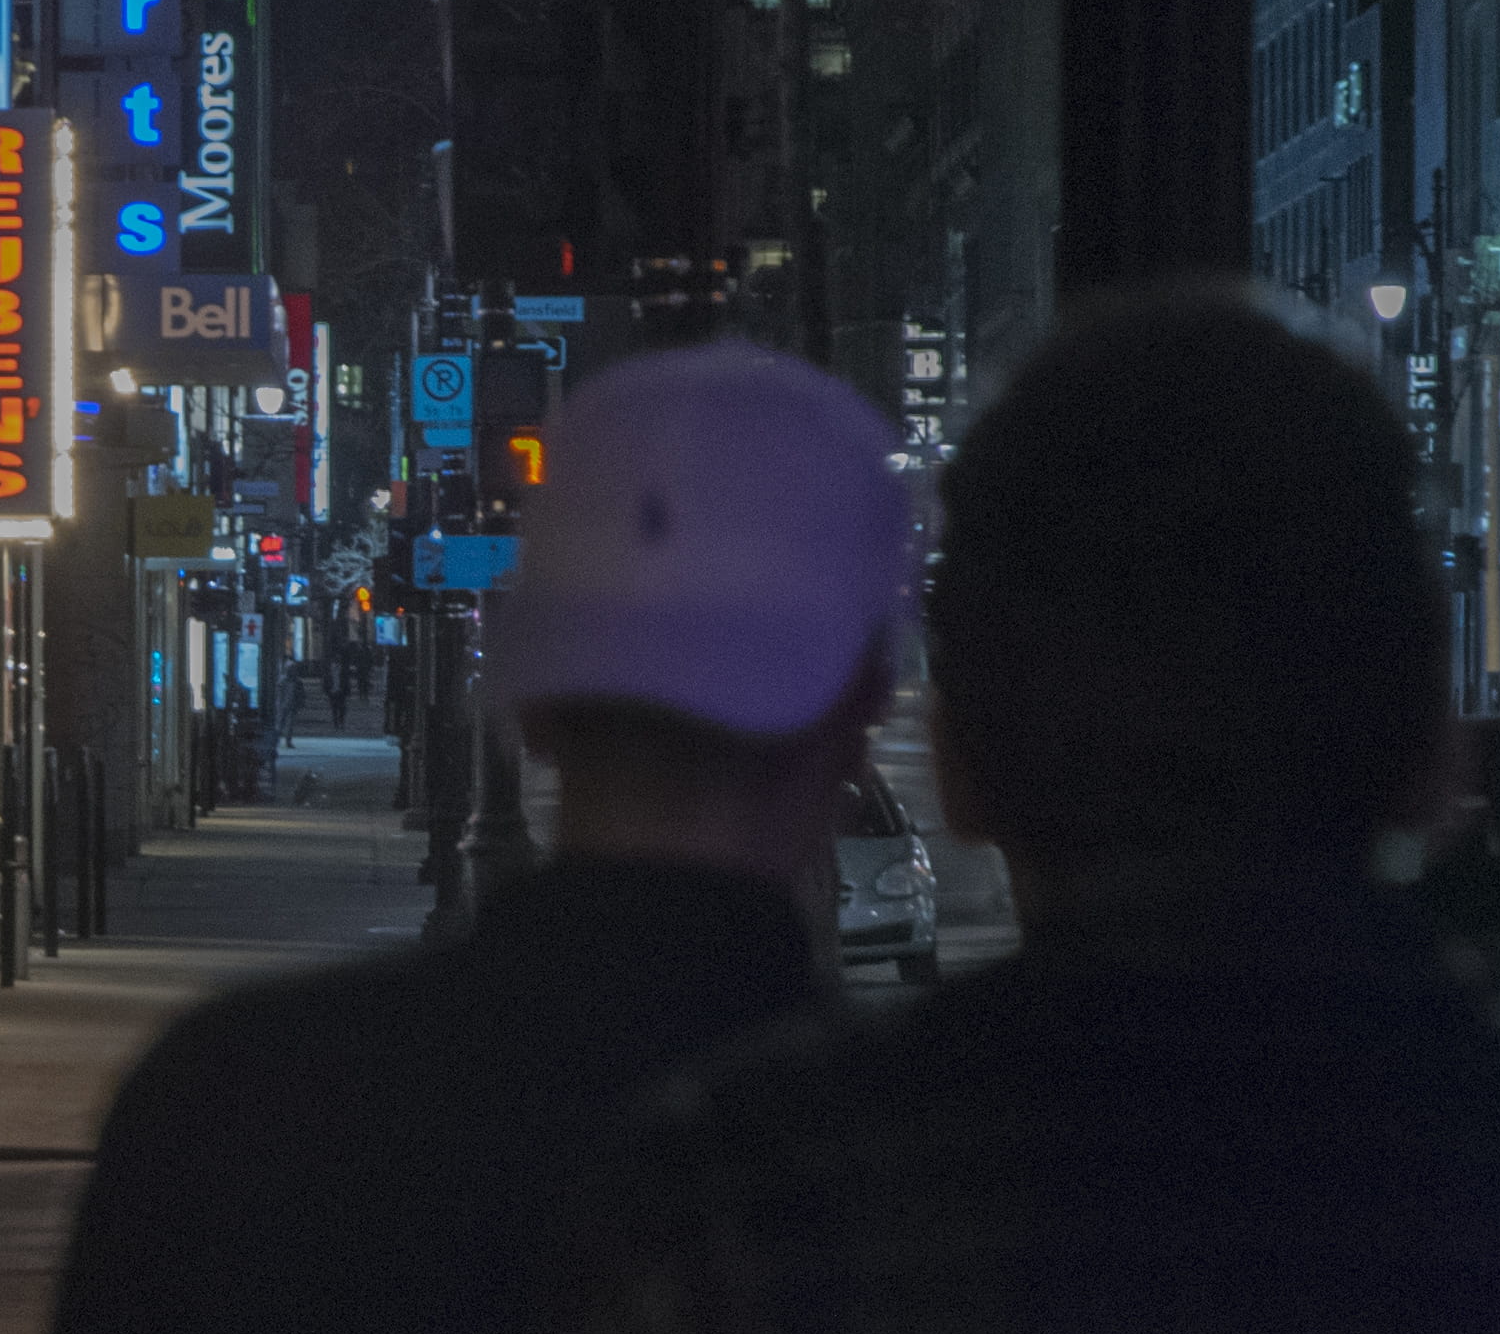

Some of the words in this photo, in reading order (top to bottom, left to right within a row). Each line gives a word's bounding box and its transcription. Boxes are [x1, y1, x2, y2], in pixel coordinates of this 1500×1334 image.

[177, 30, 236, 234] Moores
[160, 285, 251, 339] Bell
[516, 302, 578, 318] ansfield
